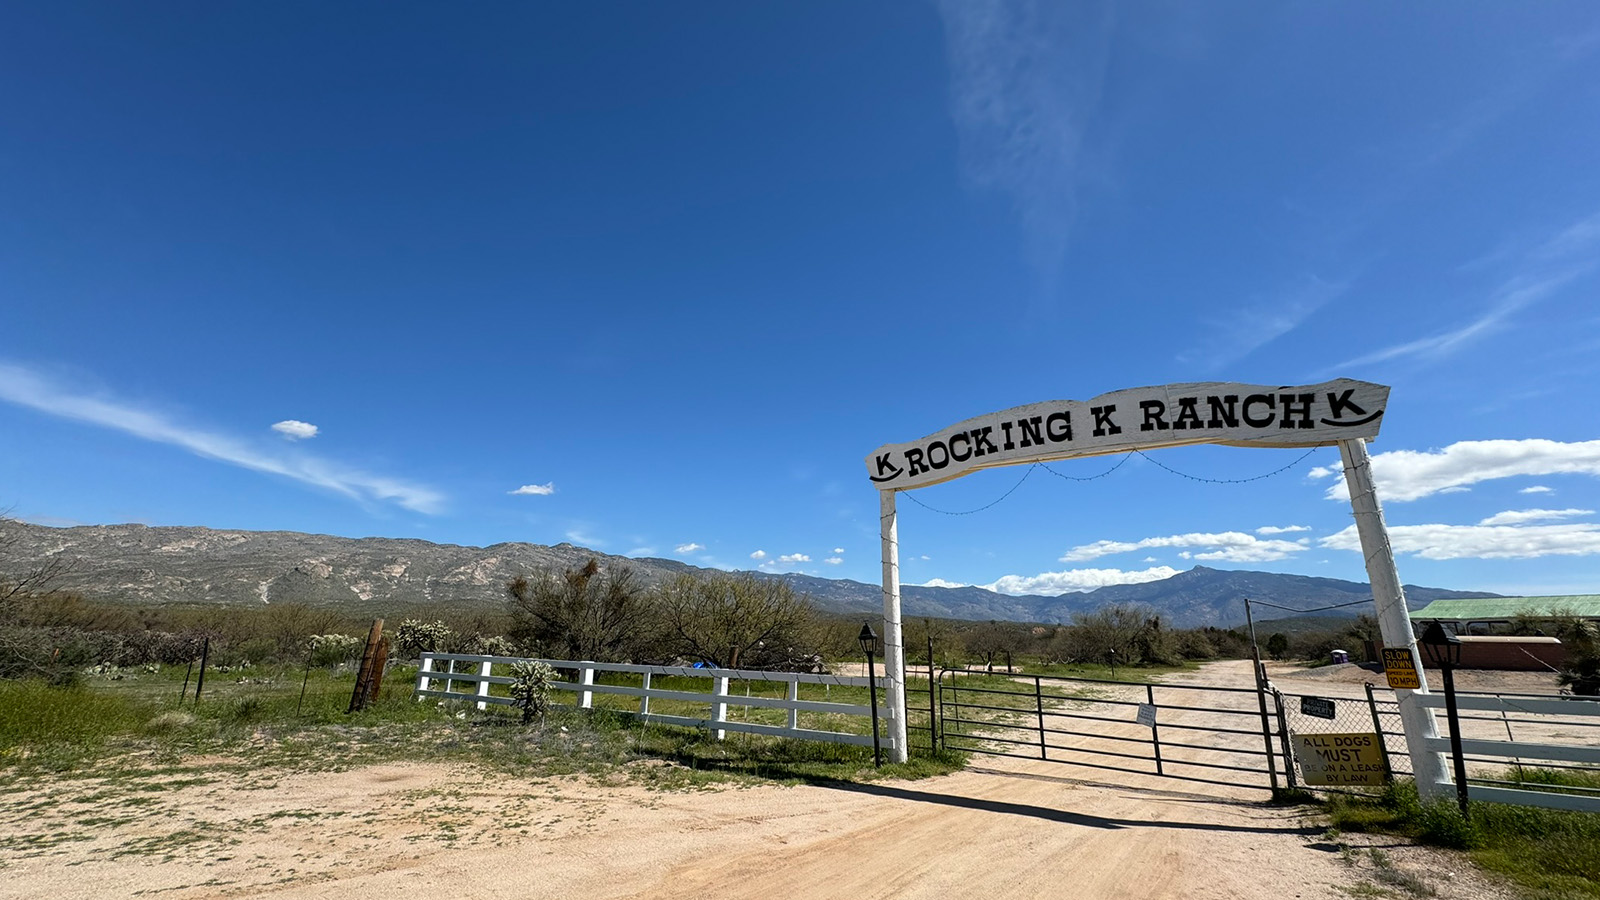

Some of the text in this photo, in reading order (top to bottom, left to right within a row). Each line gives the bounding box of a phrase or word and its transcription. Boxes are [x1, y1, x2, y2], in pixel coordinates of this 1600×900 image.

[903, 410, 1073, 477] ROCKING
[1090, 404, 1122, 437] K
[1139, 393, 1315, 432] RANCH
[1384, 651, 1409, 660] SLOW
[1386, 660, 1412, 669] DOWN
[1390, 677, 1418, 686] 10 MPH
[1303, 703, 1333, 715] PROPERTY
[1303, 736, 1371, 747] ALL DOGS
[1315, 748, 1361, 762] MUST
[1304, 764, 1318, 772] BE
[1321, 764, 1336, 772] ON
[1339, 764, 1347, 772] A
[1326, 774, 1368, 782] BY LAW
